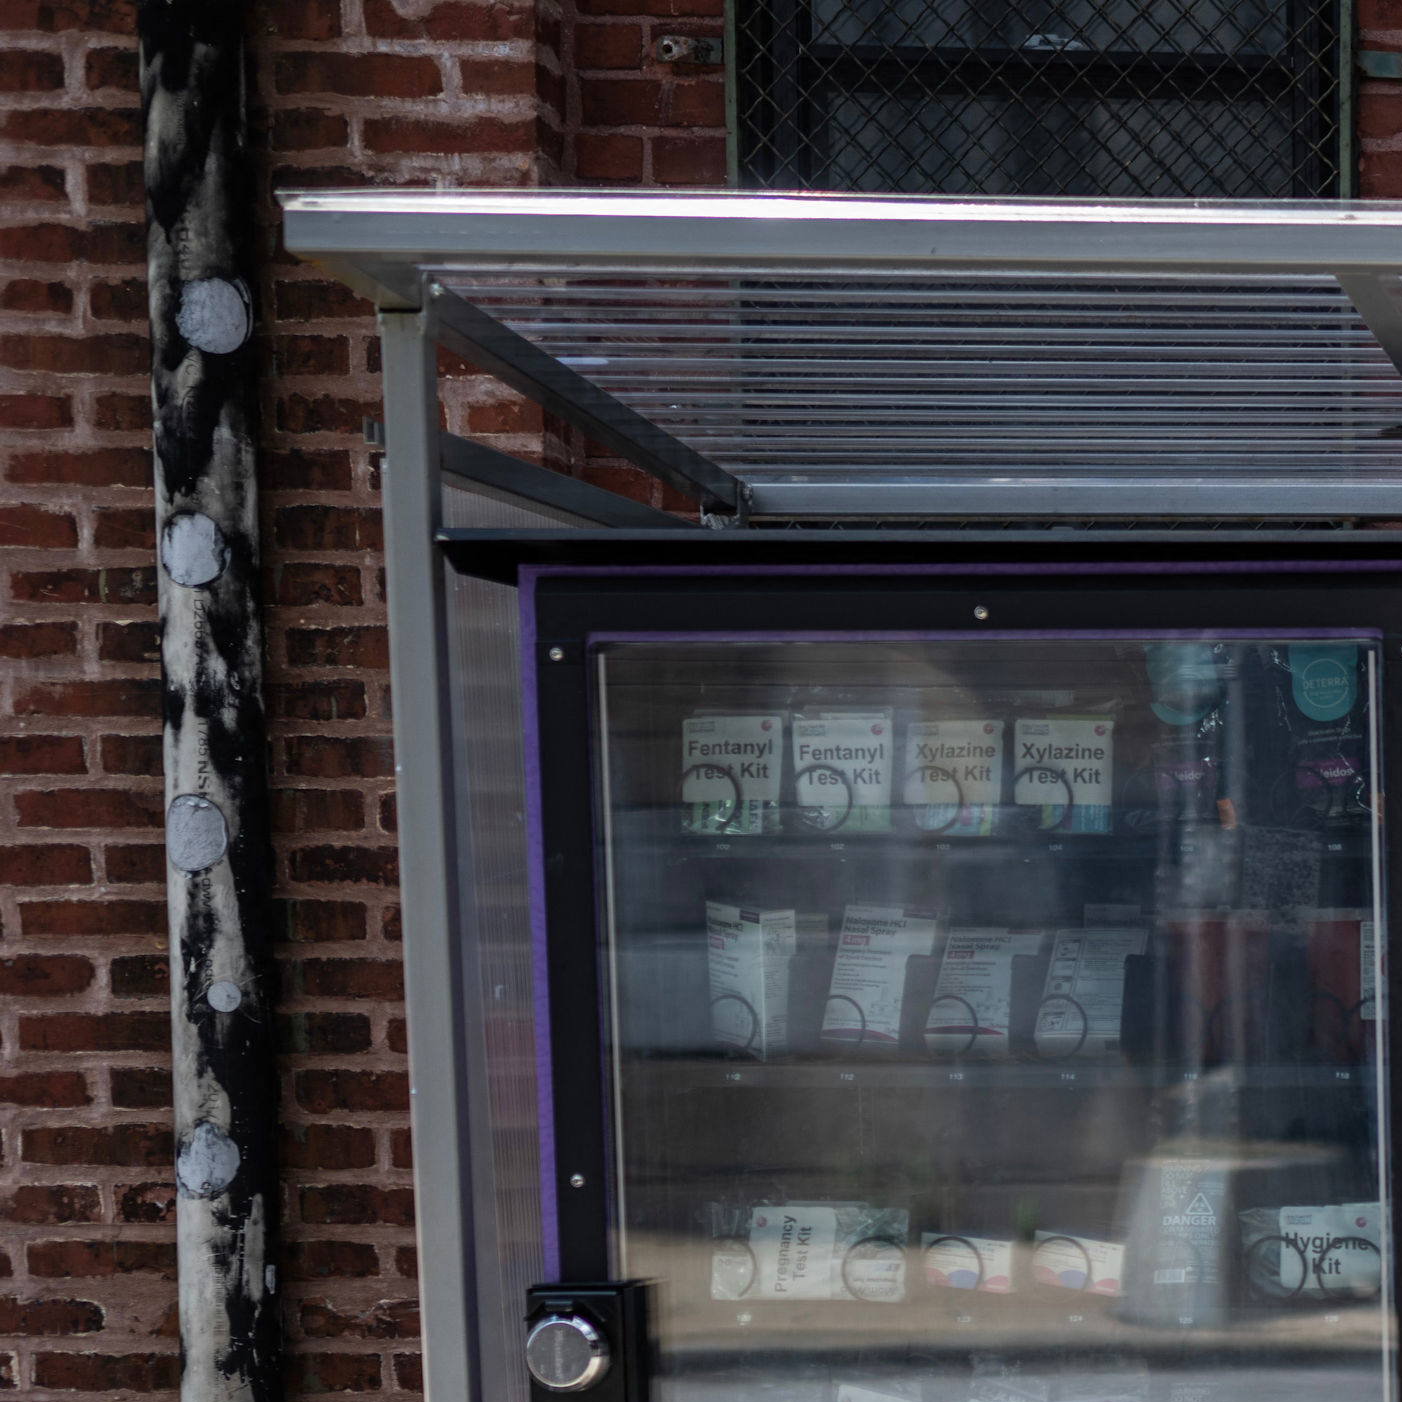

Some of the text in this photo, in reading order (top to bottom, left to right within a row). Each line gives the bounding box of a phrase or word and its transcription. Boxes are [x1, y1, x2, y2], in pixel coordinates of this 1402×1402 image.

[1303, 677, 1348, 690] DETERRA
[688, 738, 773, 758] Fentanyl
[800, 744, 884, 763] Fentanyl
[916, 743, 996, 762] Xylazine
[1022, 743, 1105, 763] Xylazine
[740, 763, 769, 779] Kit
[853, 768, 881, 785] Kit
[964, 766, 992, 782] Kit
[1073, 768, 1102, 784] Kit
[1162, 1215, 1217, 1226] DANGER
[1284, 1231, 1369, 1253] Hygiene
[775, 1215, 797, 1292] Pregnancy
[793, 1226, 812, 1281] Test Kit
[1312, 1257, 1341, 1275] Kit
